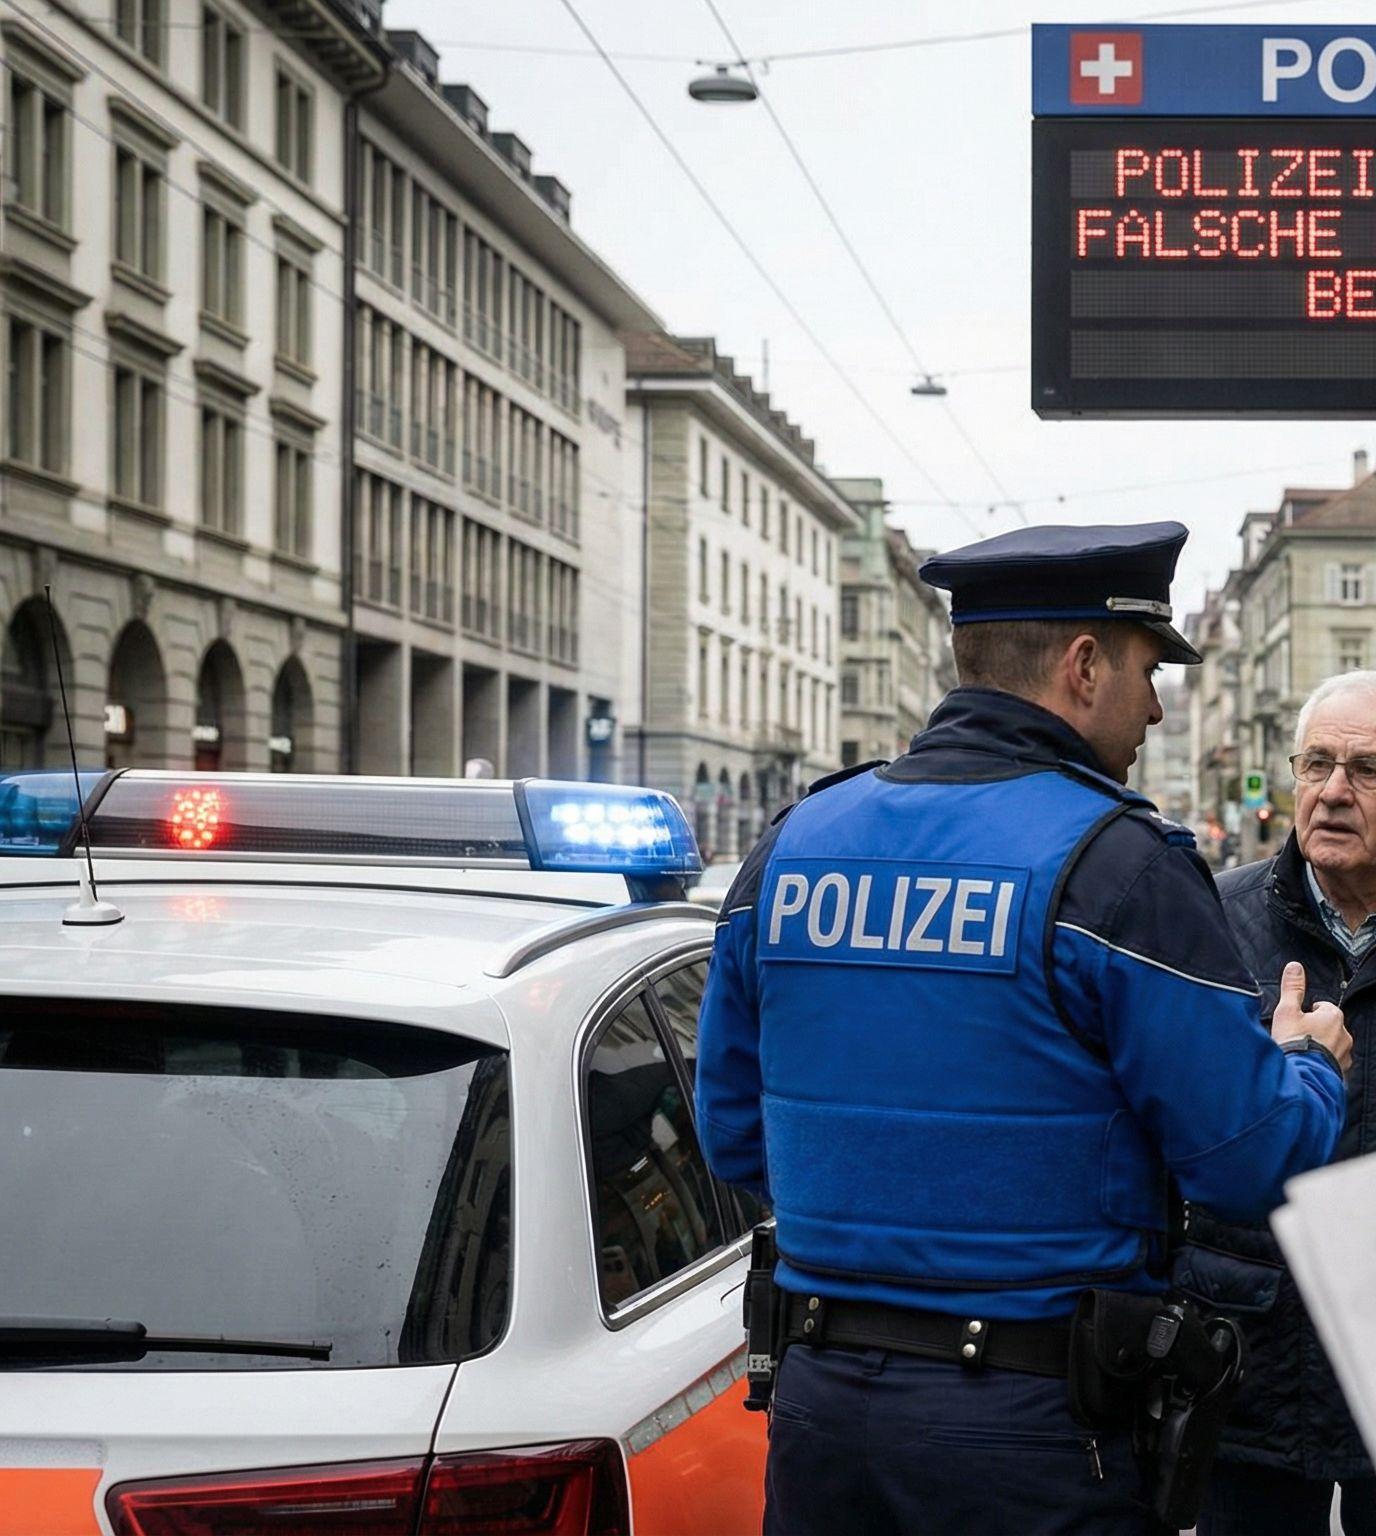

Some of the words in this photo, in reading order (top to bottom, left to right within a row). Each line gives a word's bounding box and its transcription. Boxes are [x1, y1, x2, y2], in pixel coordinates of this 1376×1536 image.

[1115, 148, 1375, 198] POLIZEI
[1077, 208, 1343, 258] FALSCHE
[769, 872, 1015, 957] POLIZEI
